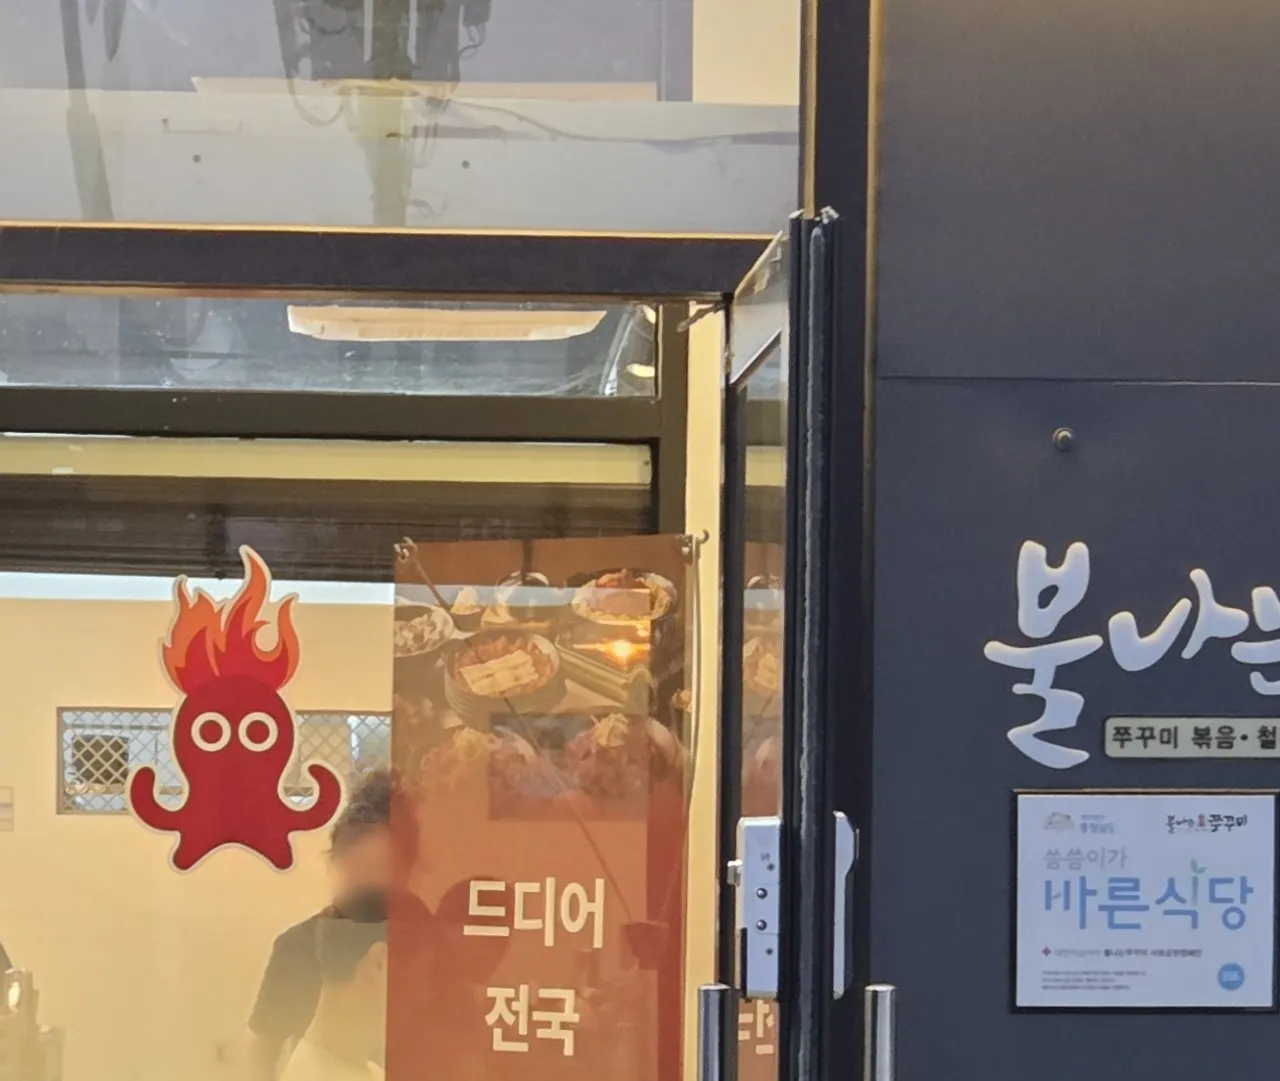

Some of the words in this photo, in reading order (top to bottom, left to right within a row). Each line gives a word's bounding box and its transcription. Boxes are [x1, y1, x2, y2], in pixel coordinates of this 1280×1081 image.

[1112, 726, 1178, 749] 쭈꾸미
[1043, 847, 1128, 870] 씀씀이가
[463, 876, 605, 948] 드디어
[1045, 875, 1253, 930] 바른식당
[483, 984, 580, 1056] 전국
